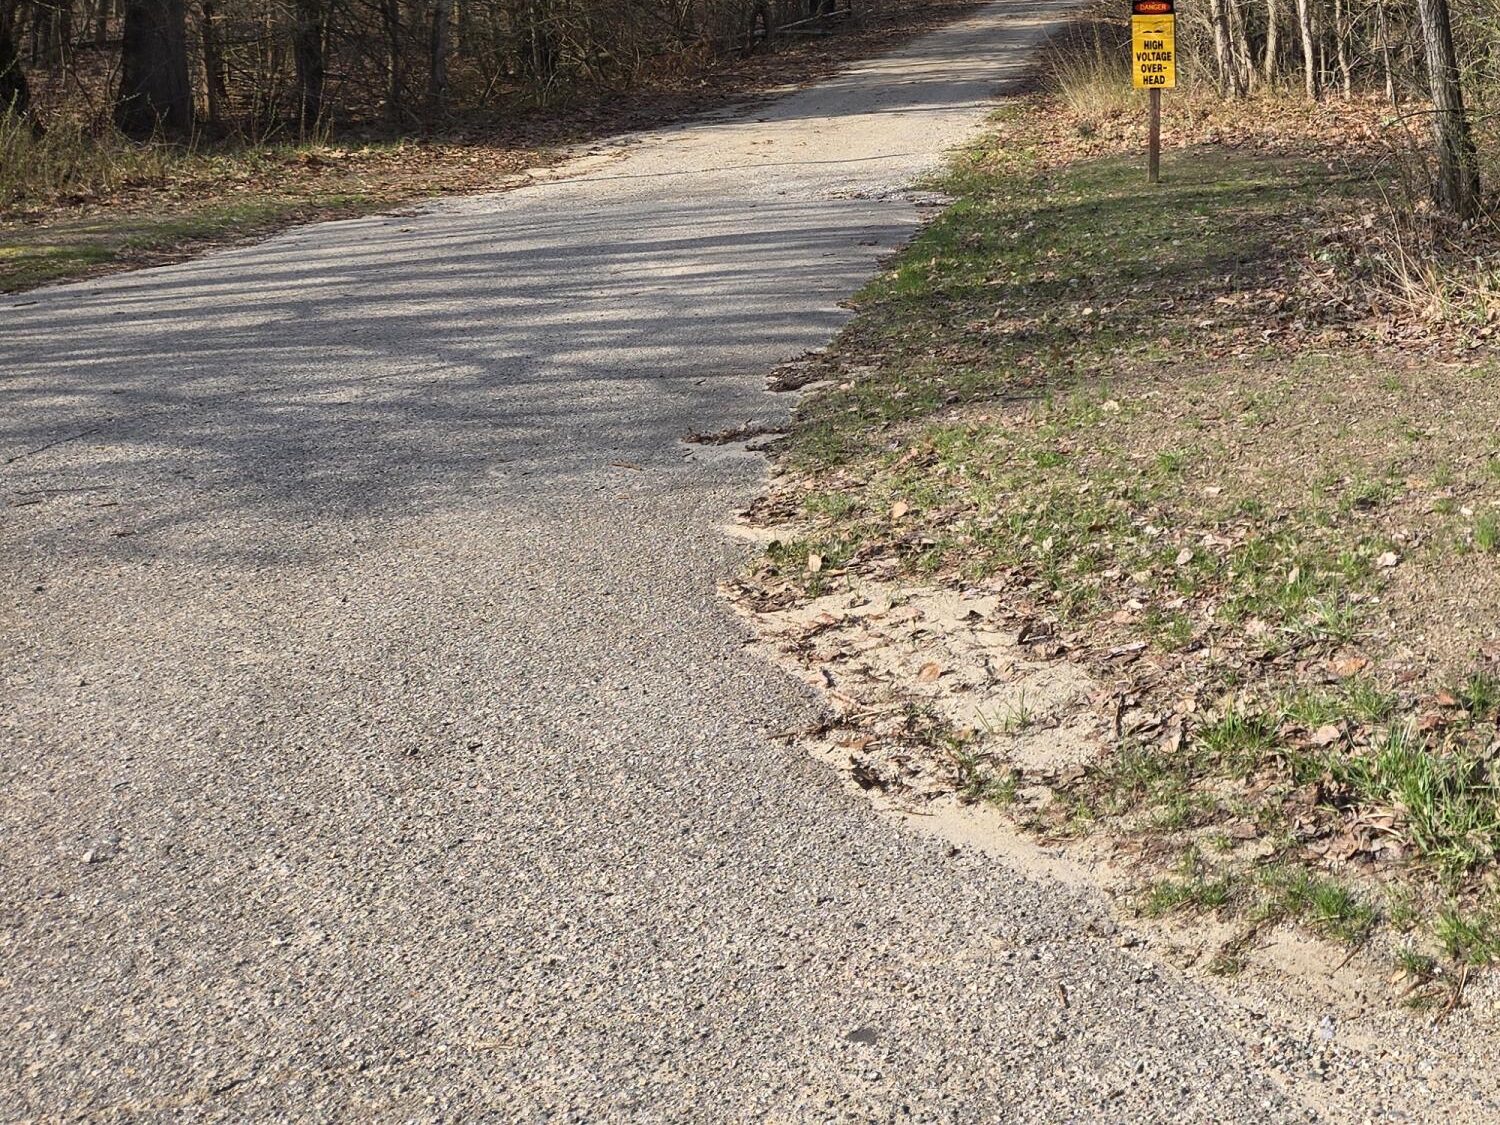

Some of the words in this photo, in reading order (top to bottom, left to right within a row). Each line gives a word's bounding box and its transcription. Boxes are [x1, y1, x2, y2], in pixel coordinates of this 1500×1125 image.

[1140, 3, 1167, 11] DANGER
[1143, 40, 1164, 50] HIGH
[1136, 52, 1172, 62] VOLTAGE
[1141, 63, 1167, 73] OVER-
[1143, 75, 1166, 85] HEAD
